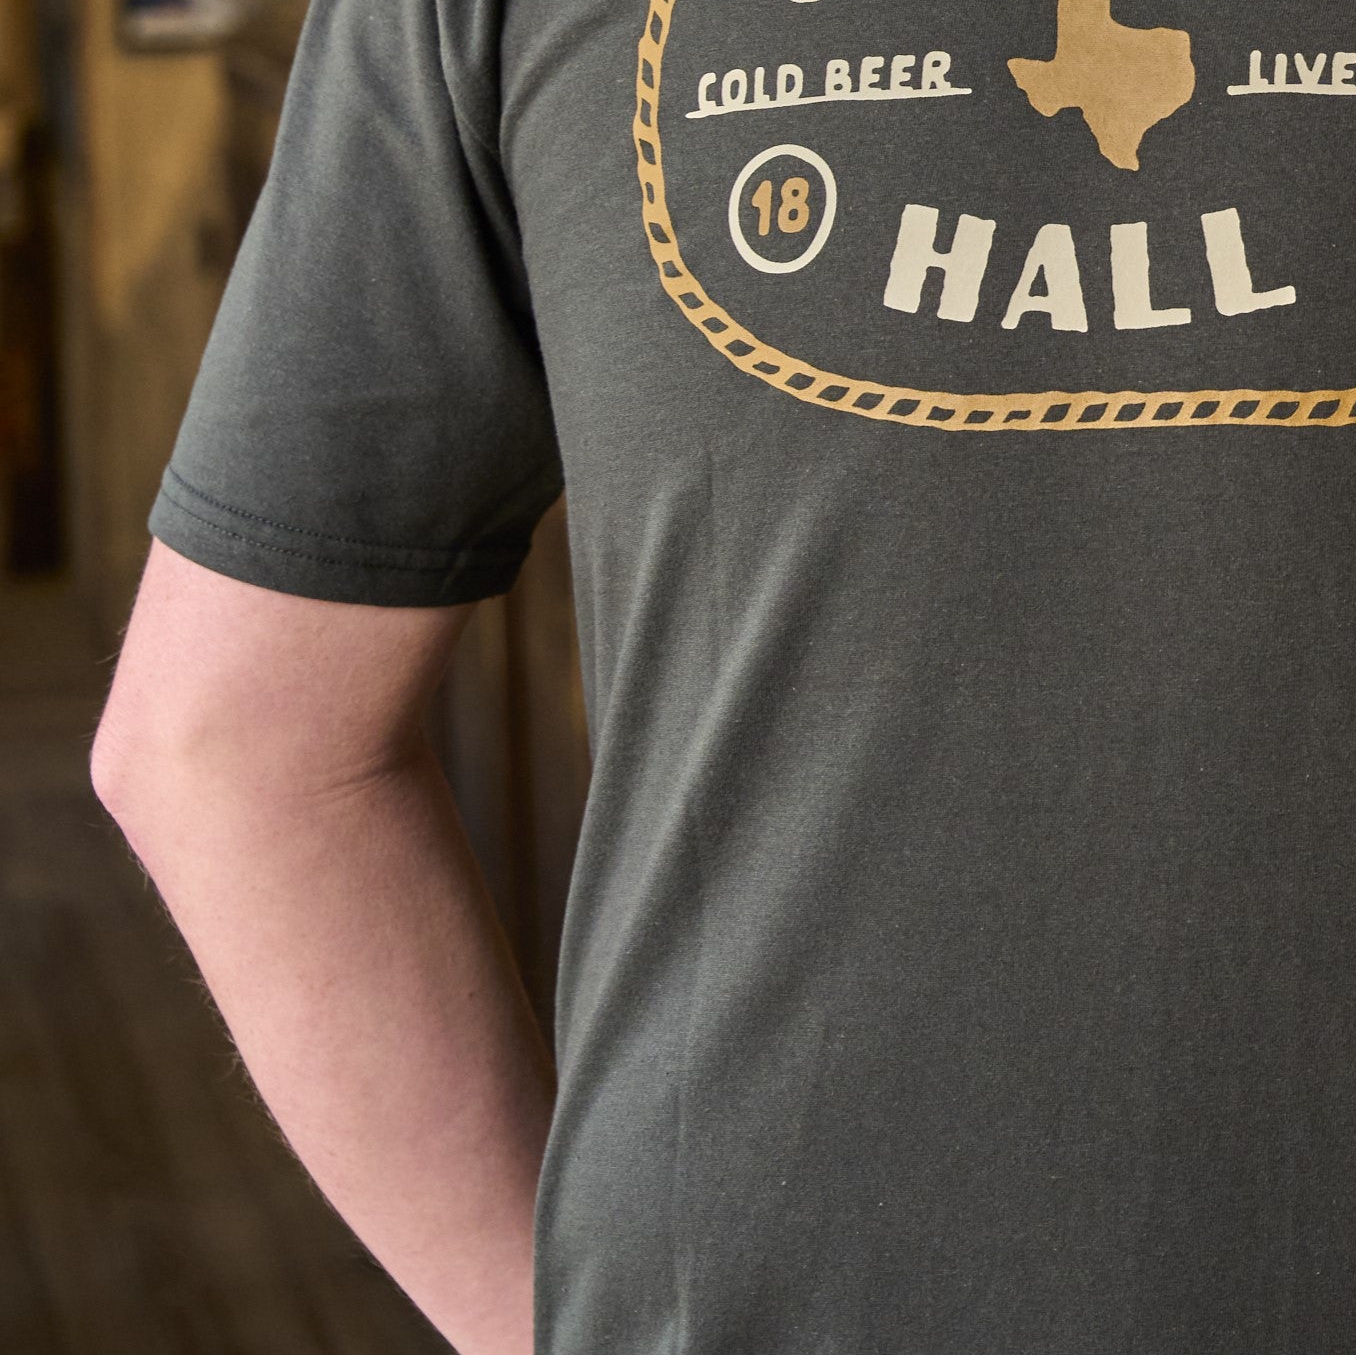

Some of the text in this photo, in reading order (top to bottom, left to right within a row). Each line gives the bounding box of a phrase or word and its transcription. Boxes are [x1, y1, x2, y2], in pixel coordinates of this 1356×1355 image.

[697, 50, 953, 111] COLD BEER
[751, 176, 810, 236] 18
[882, 203, 1297, 334] HALL
